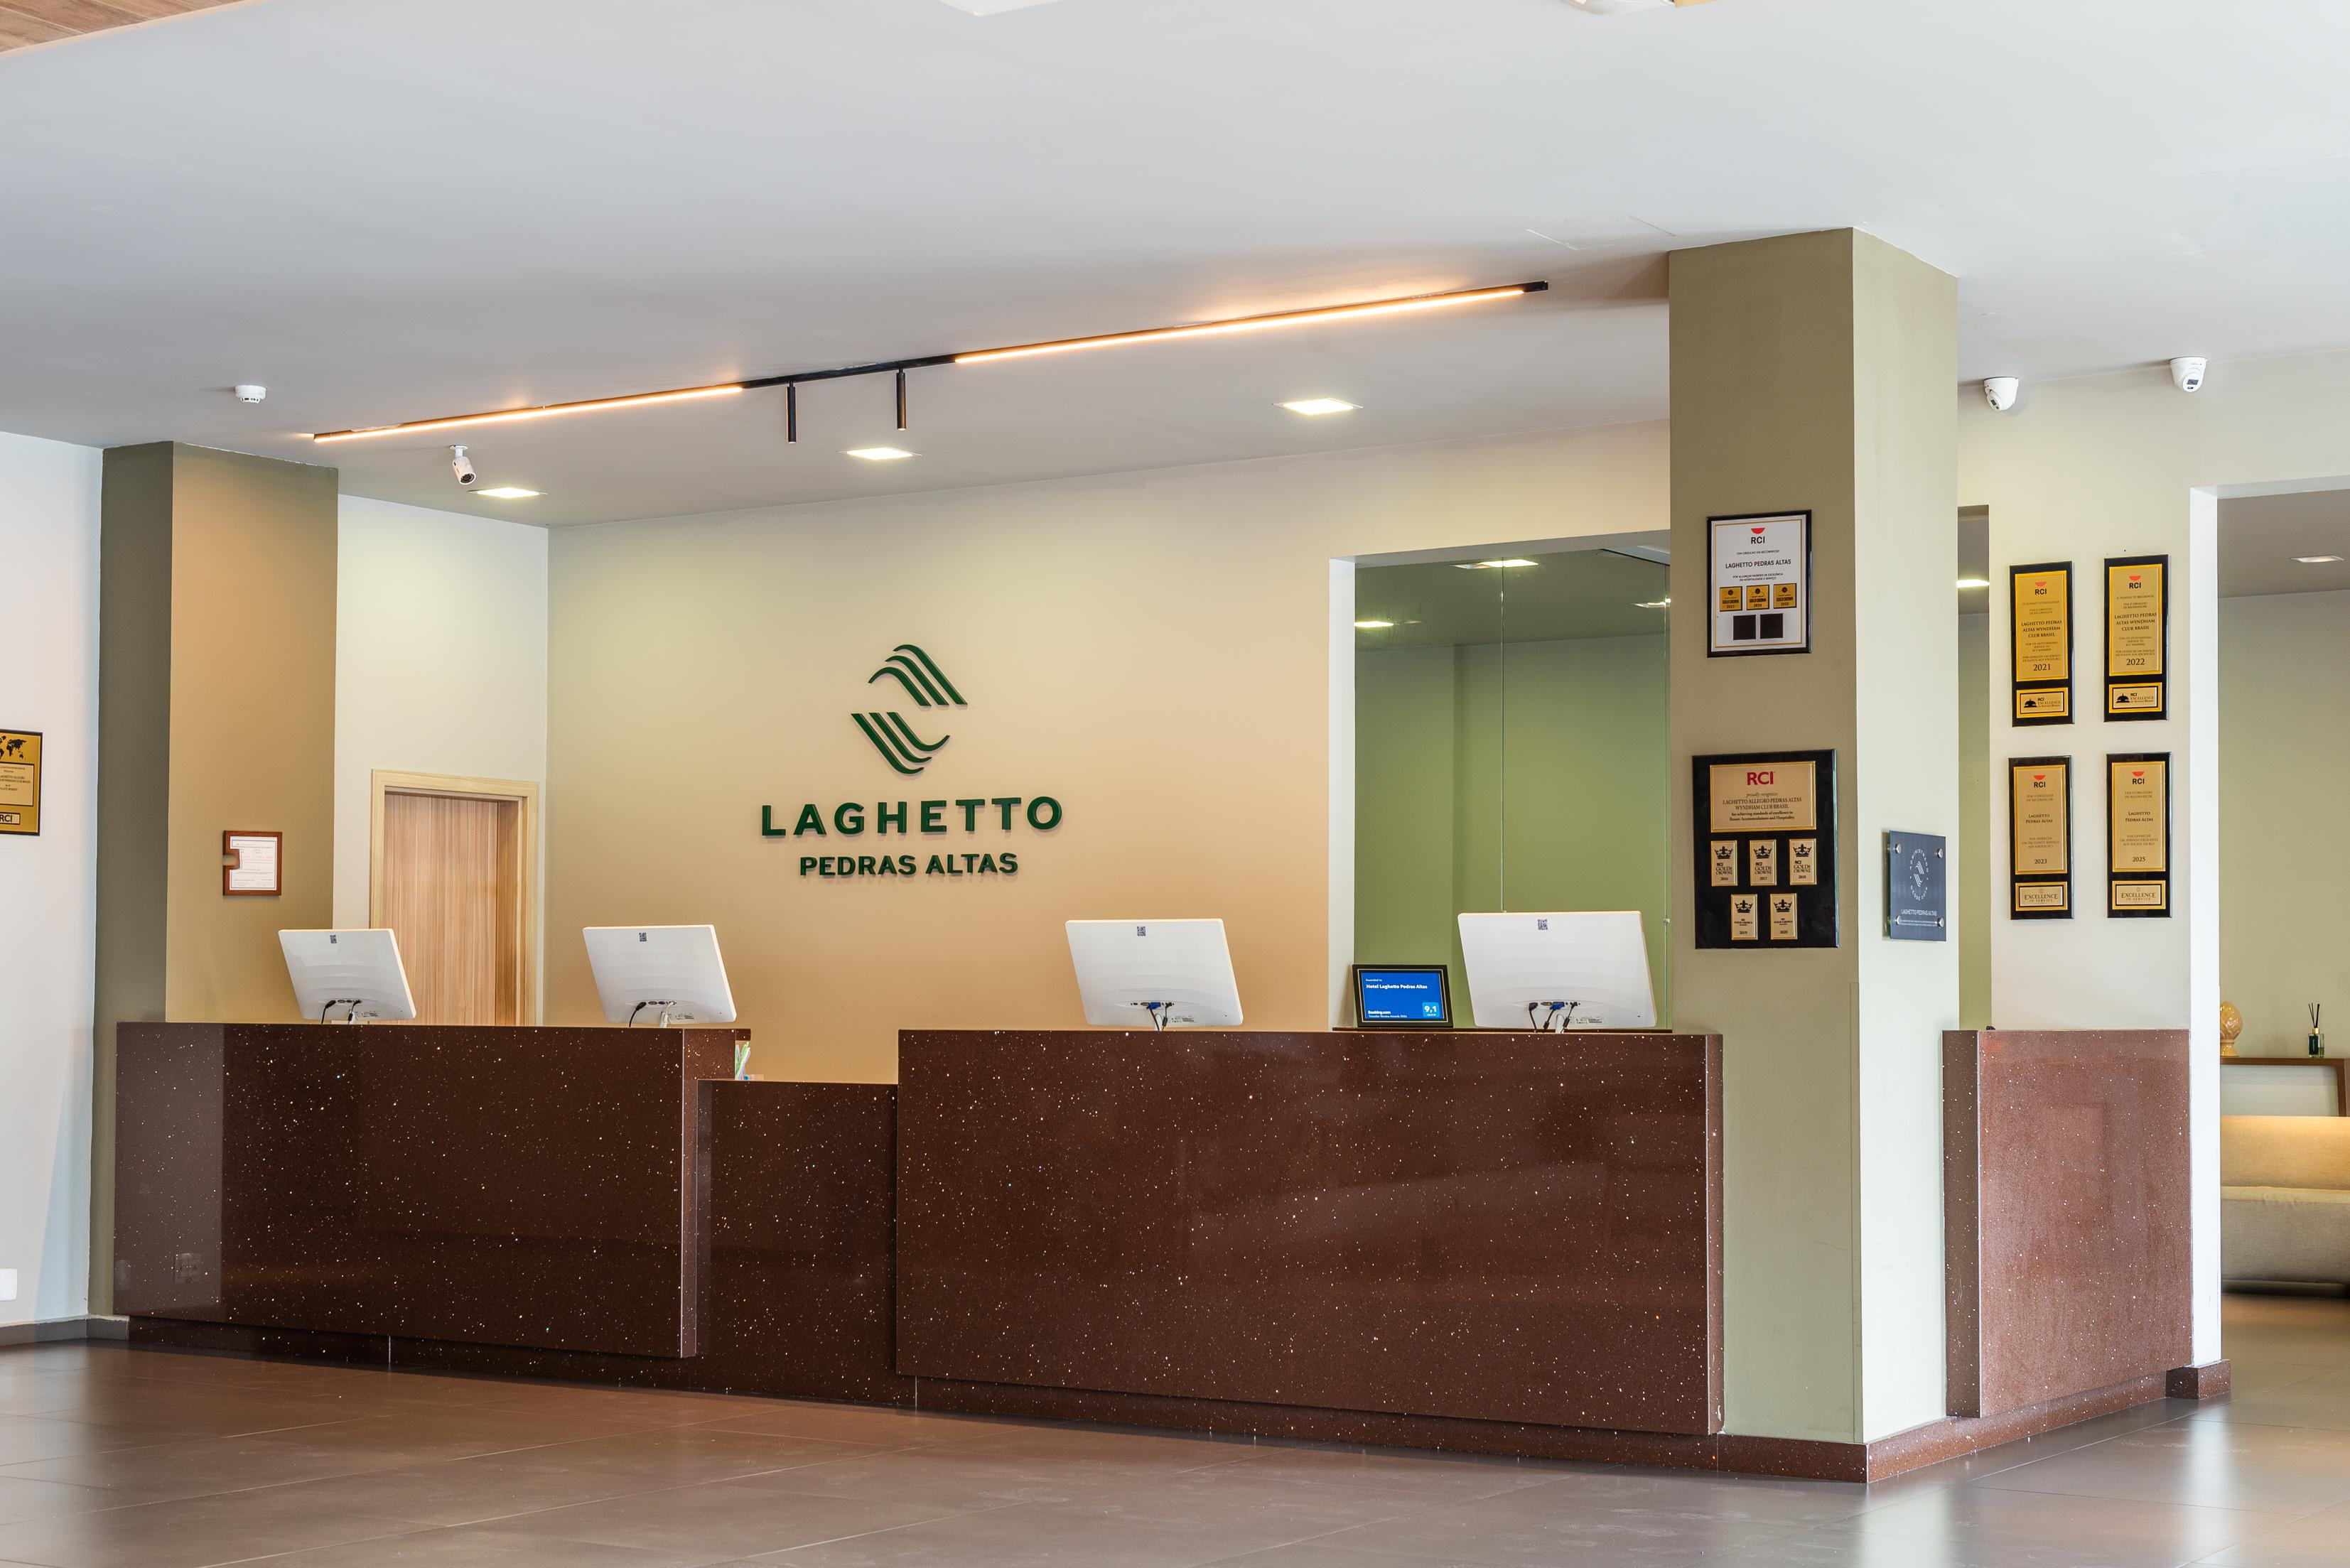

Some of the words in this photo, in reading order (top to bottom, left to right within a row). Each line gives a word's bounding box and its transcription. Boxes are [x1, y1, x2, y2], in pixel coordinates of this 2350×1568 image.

[1747, 771, 1774, 786] RCI
[762, 796, 1062, 836] LAGHETTO
[800, 855, 917, 876] PEDRAS
[925, 853, 1018, 875] ALTAS
